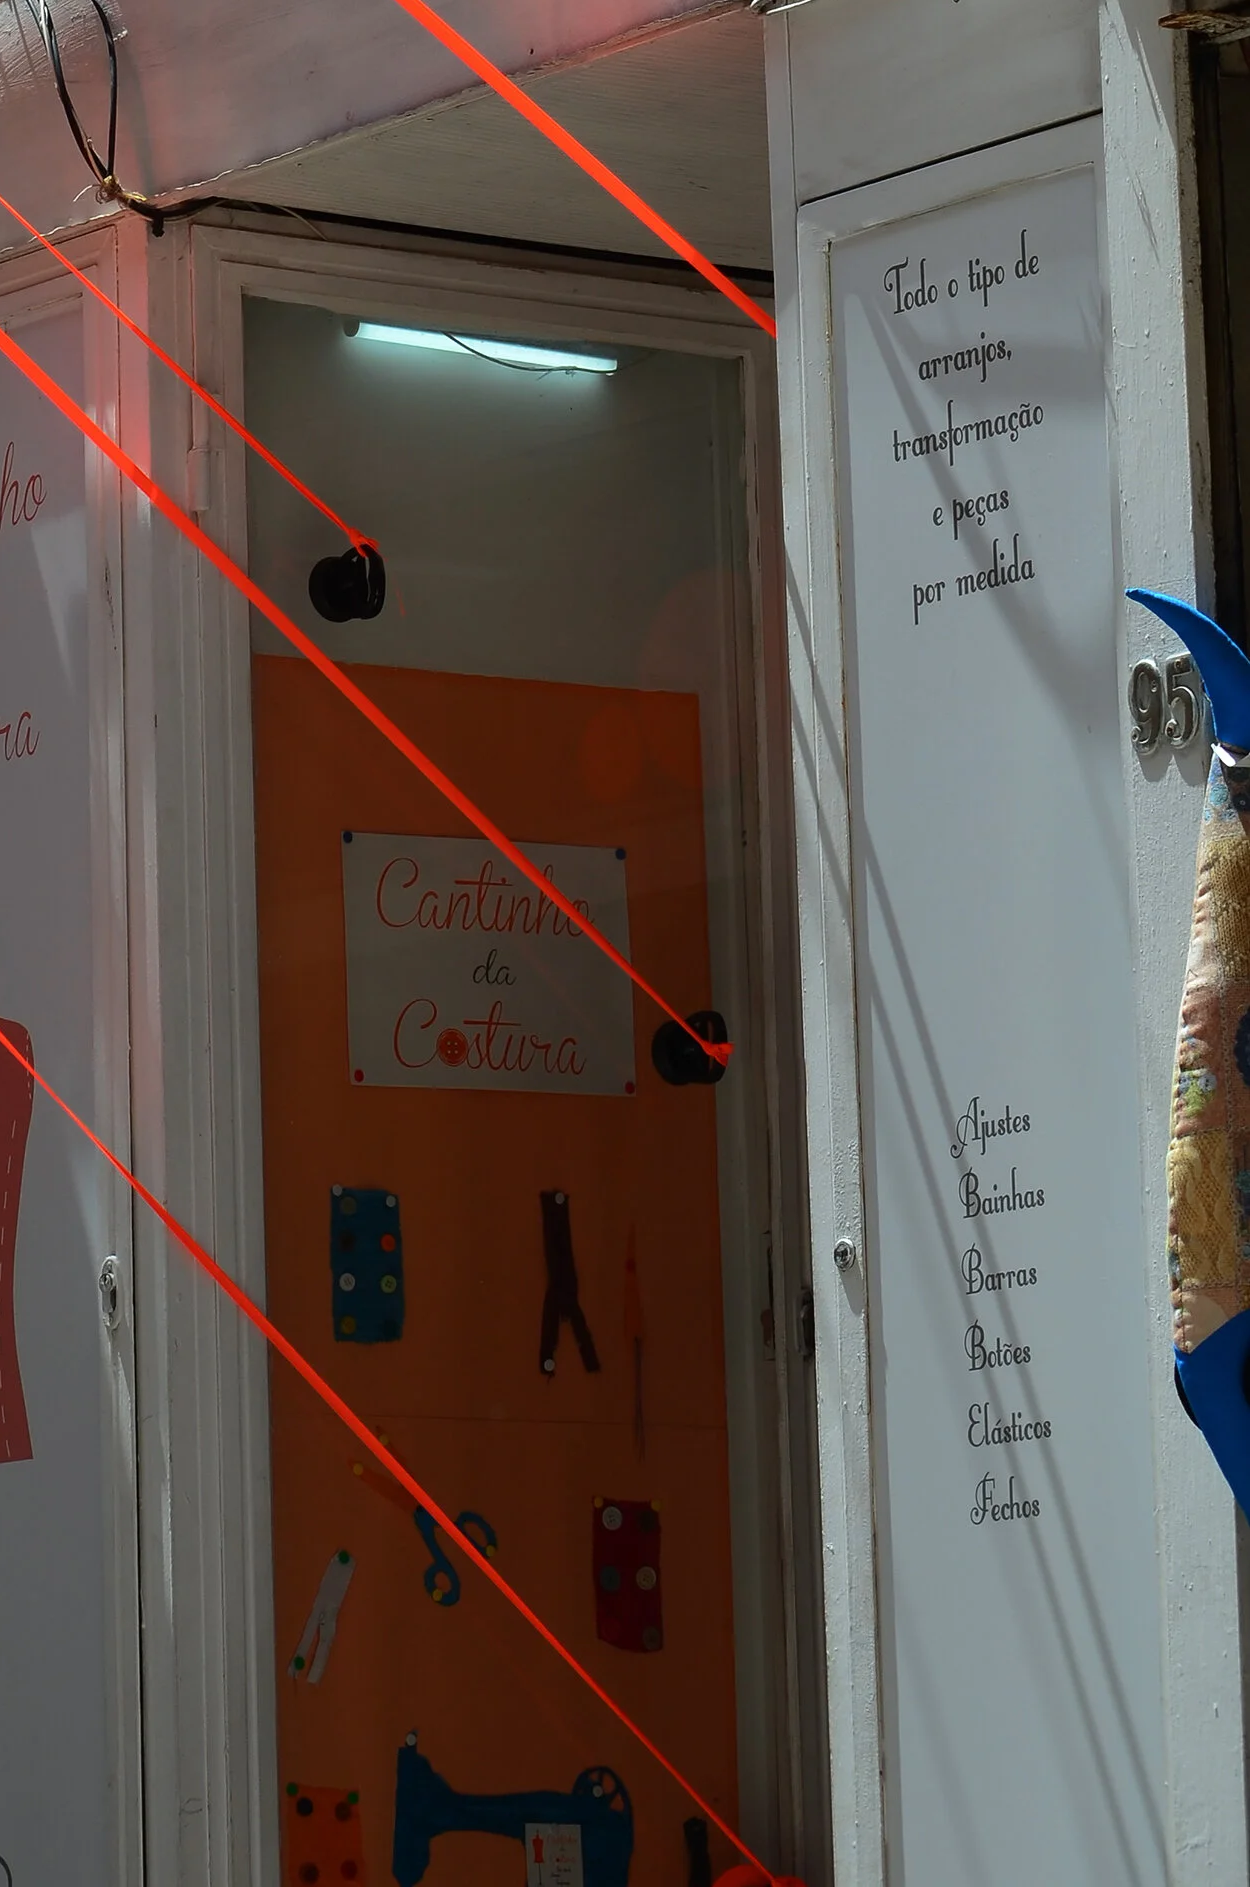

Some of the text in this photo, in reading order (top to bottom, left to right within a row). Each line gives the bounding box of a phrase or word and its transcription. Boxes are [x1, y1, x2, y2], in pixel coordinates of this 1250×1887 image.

[883, 229, 1040, 315] Todo o tipo de
[918, 331, 1013, 383] arranjos,
[893, 400, 1044, 466] transformação
[932, 490, 1010, 541] e peças
[913, 533, 1036, 626] por medida
[1129, 653, 1199, 755] 95
[377, 857, 595, 937] Cantinho
[472, 949, 517, 986] da
[394, 998, 587, 1076] Costura
[950, 1096, 1031, 1159] Ajustes
[958, 1166, 1046, 1219] Bainhas
[961, 1242, 1038, 1296] Barras
[964, 1319, 1032, 1372] Botões
[967, 1402, 1052, 1448] Elásticos
[970, 1472, 1041, 1525] Fechos
